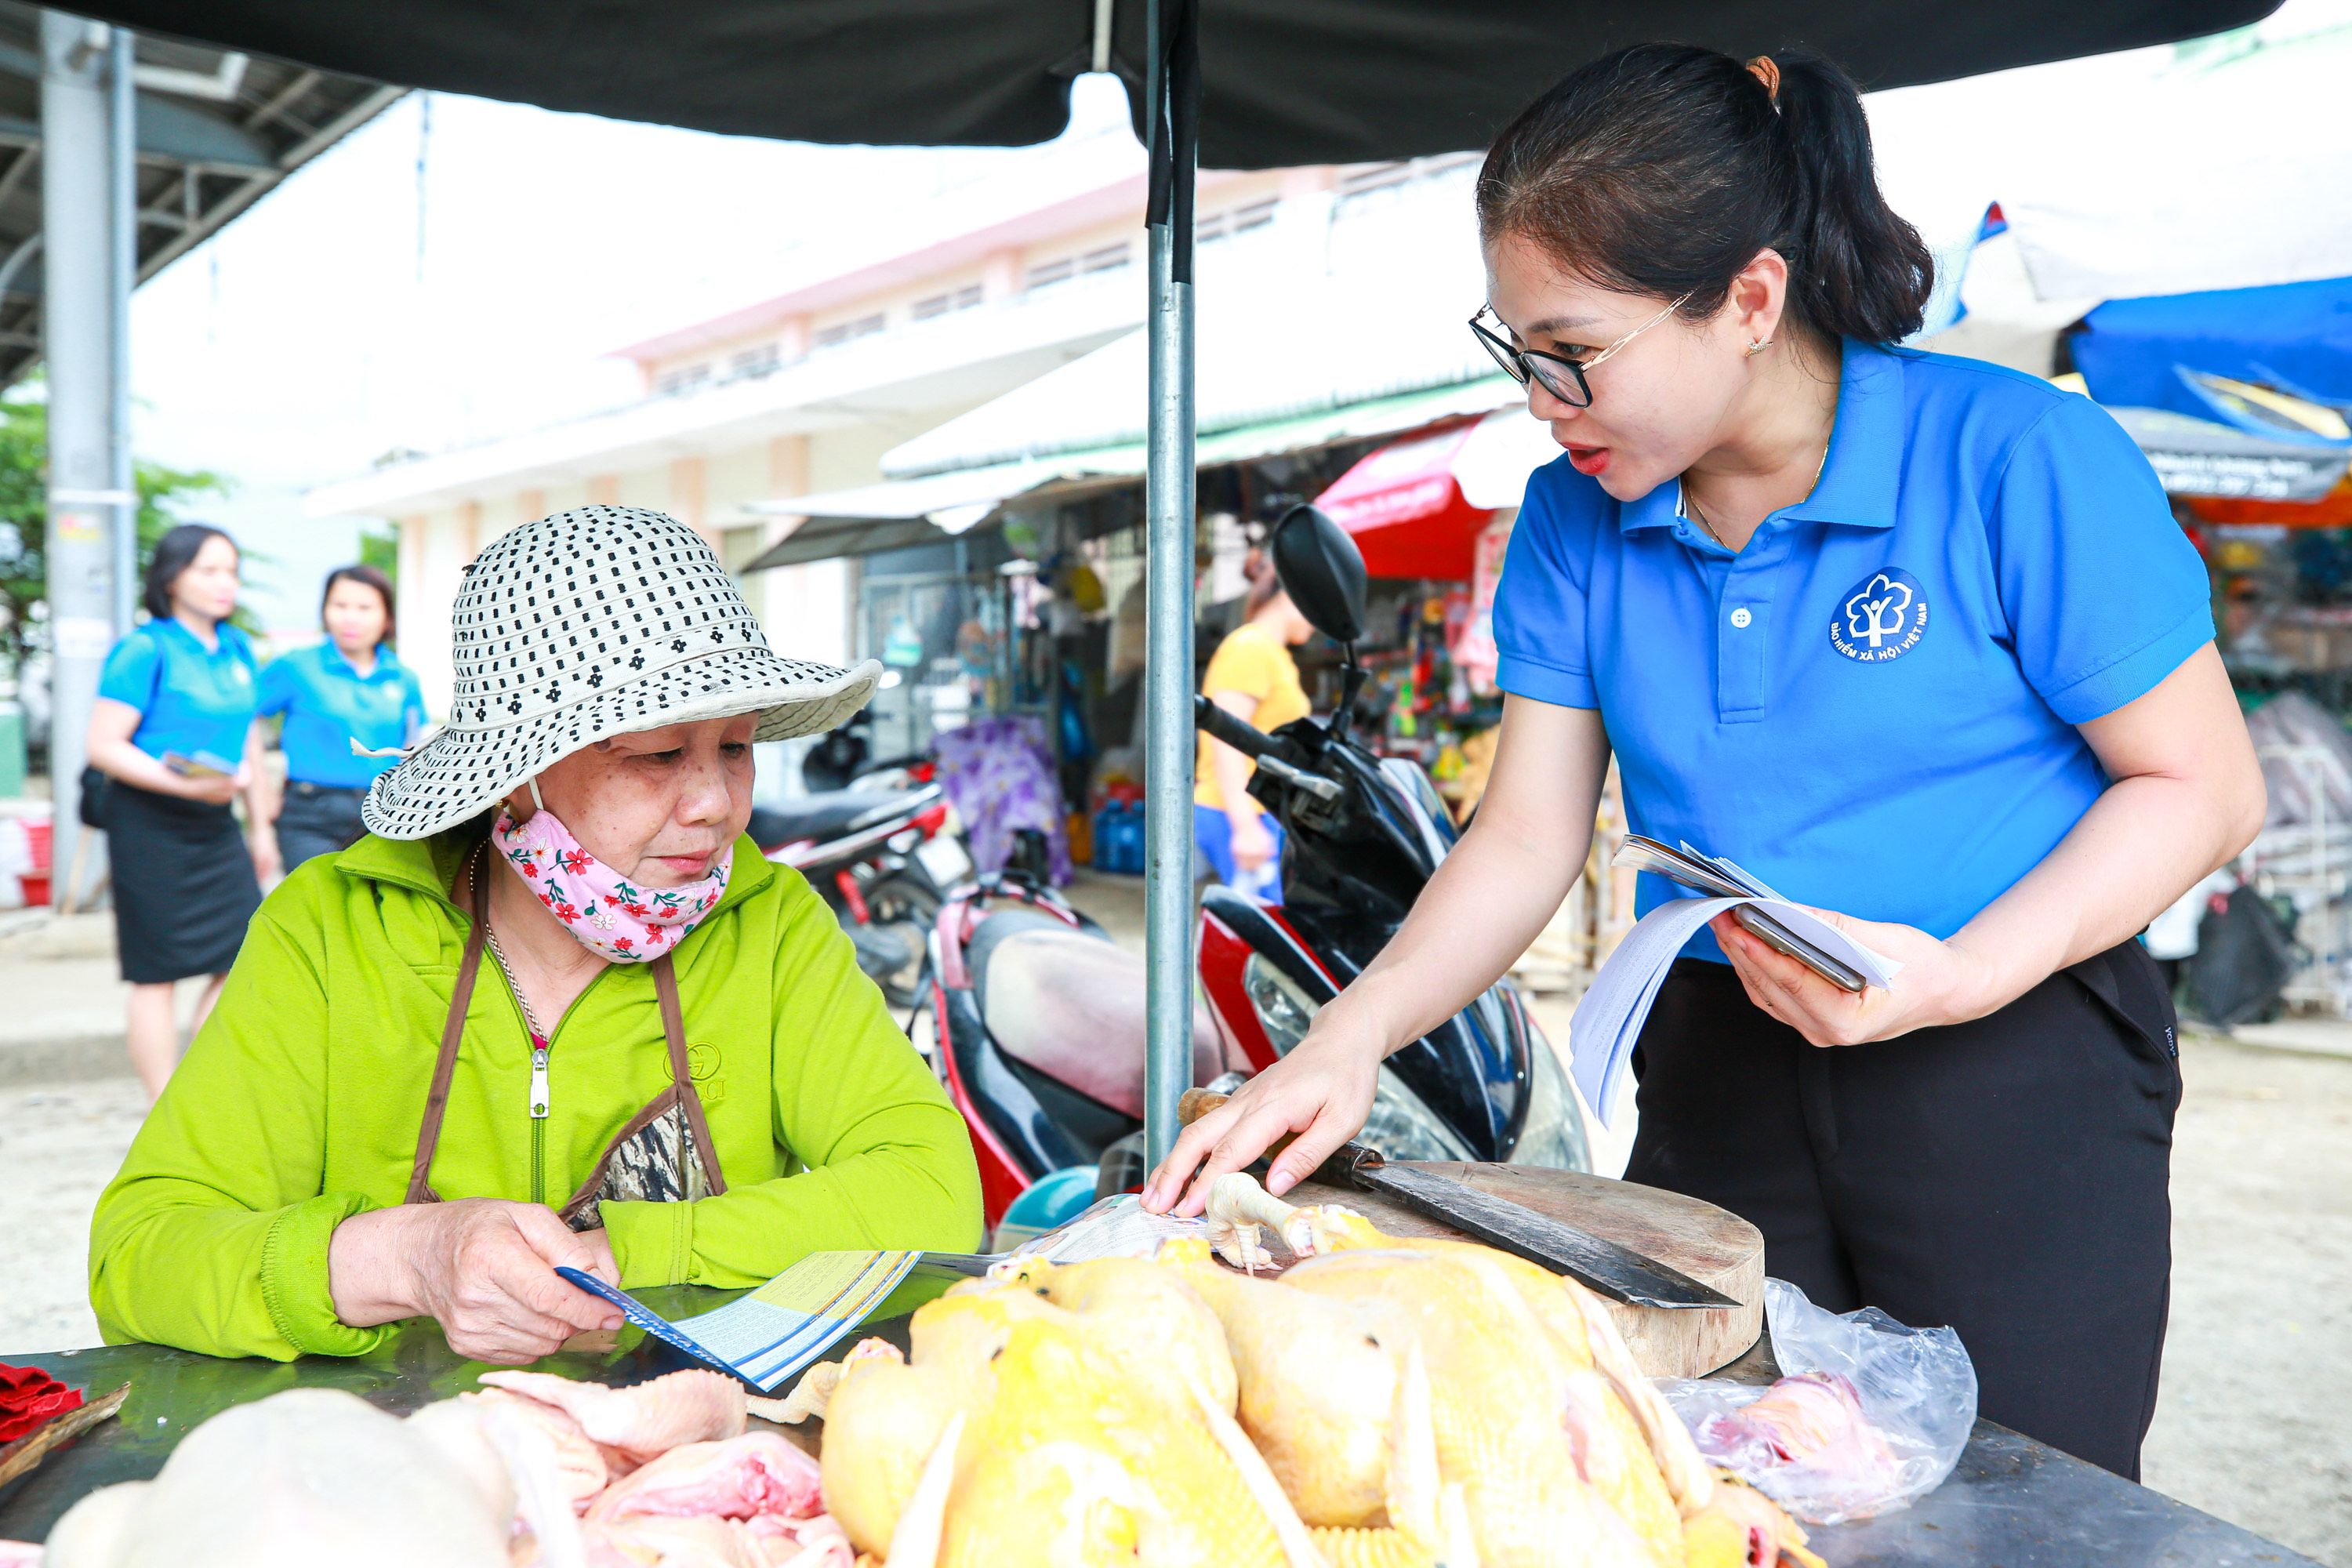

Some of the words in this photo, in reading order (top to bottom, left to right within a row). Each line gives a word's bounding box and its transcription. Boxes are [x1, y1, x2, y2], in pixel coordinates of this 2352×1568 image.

[1917, 603, 1927, 626] NAM
[1831, 622, 1839, 640] BẢO
[1901, 626, 1922, 649] VIỆT
[1834, 638, 1857, 659] HIỂM
[1859, 650, 1875, 661] XÃ
[1878, 646, 1901, 659] HỘI
